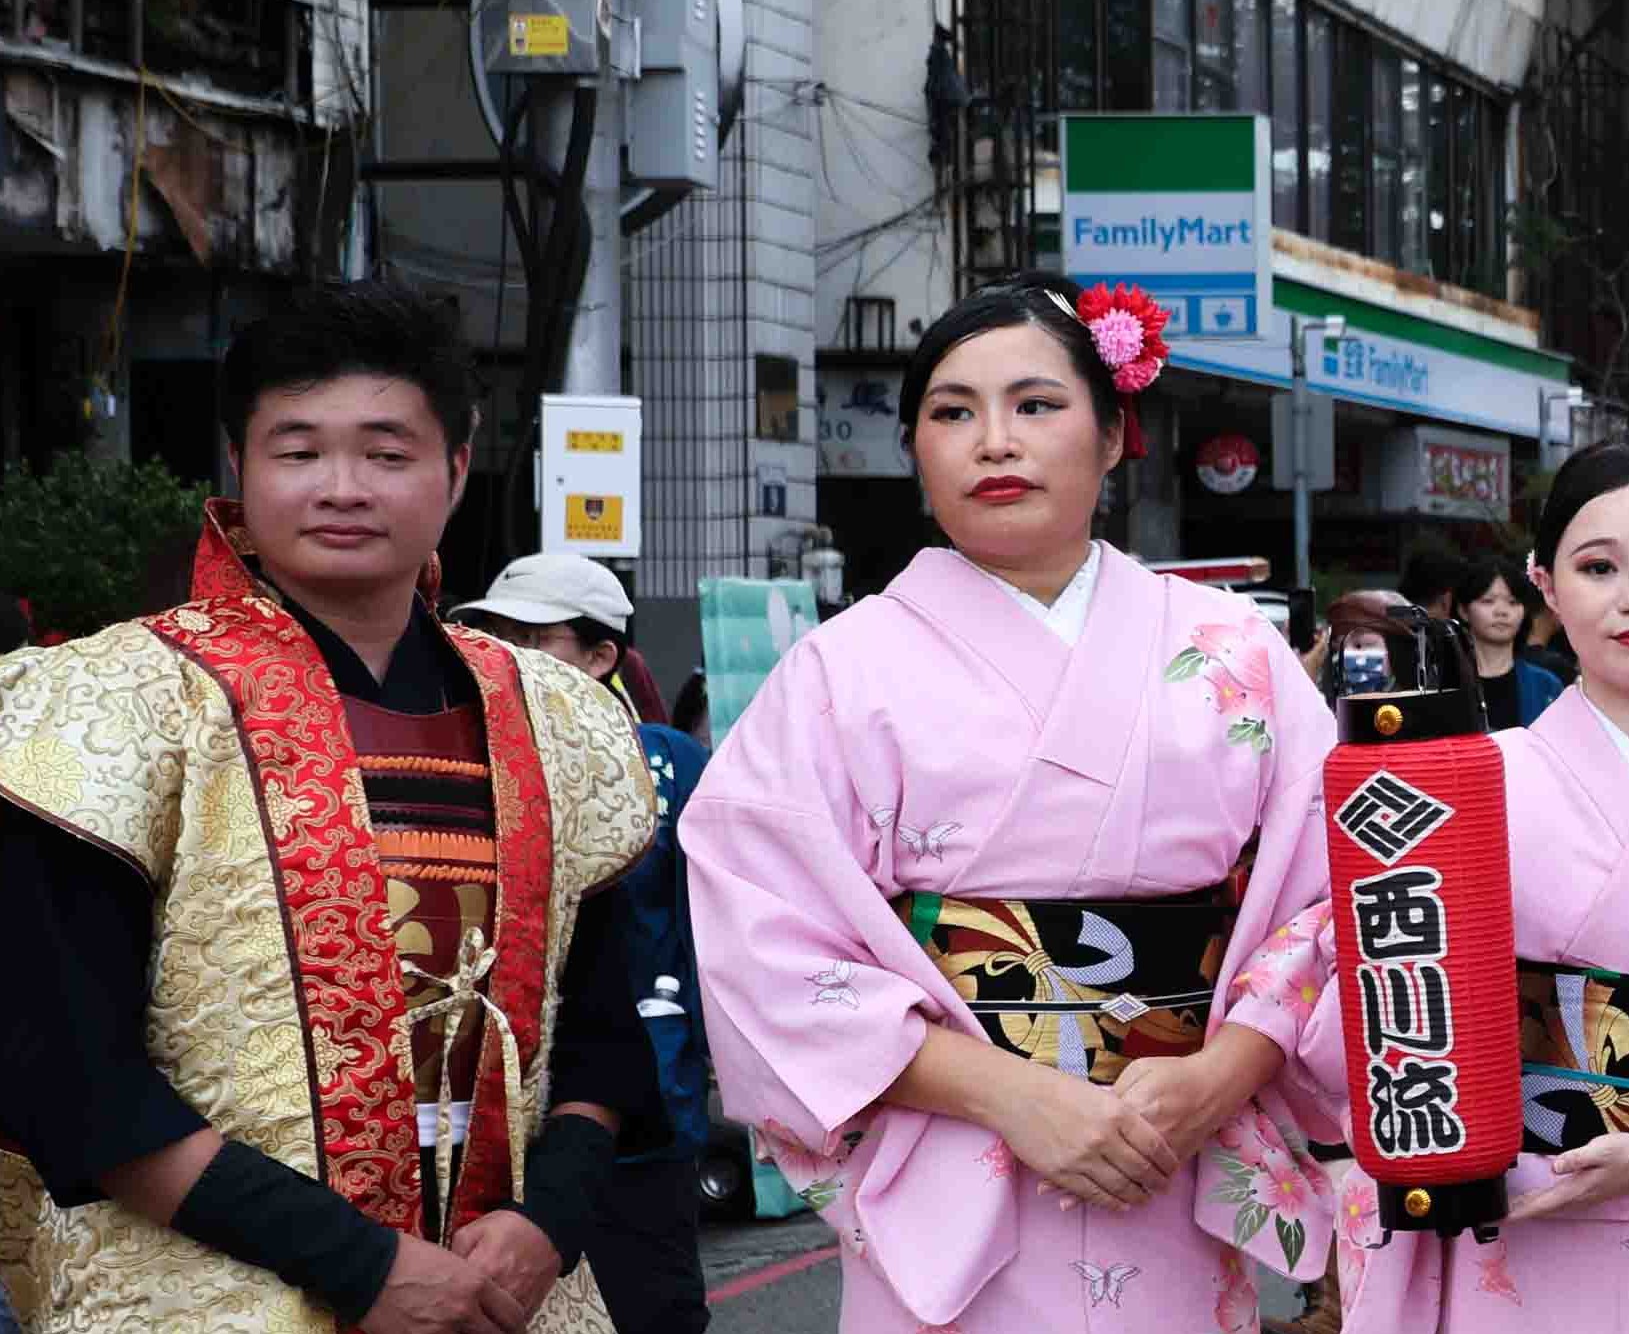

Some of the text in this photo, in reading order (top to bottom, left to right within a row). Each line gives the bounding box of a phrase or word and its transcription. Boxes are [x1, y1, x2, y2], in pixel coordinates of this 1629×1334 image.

[1074, 215, 1251, 254] FamilyMart
[1352, 866, 1466, 1159] 西川流
